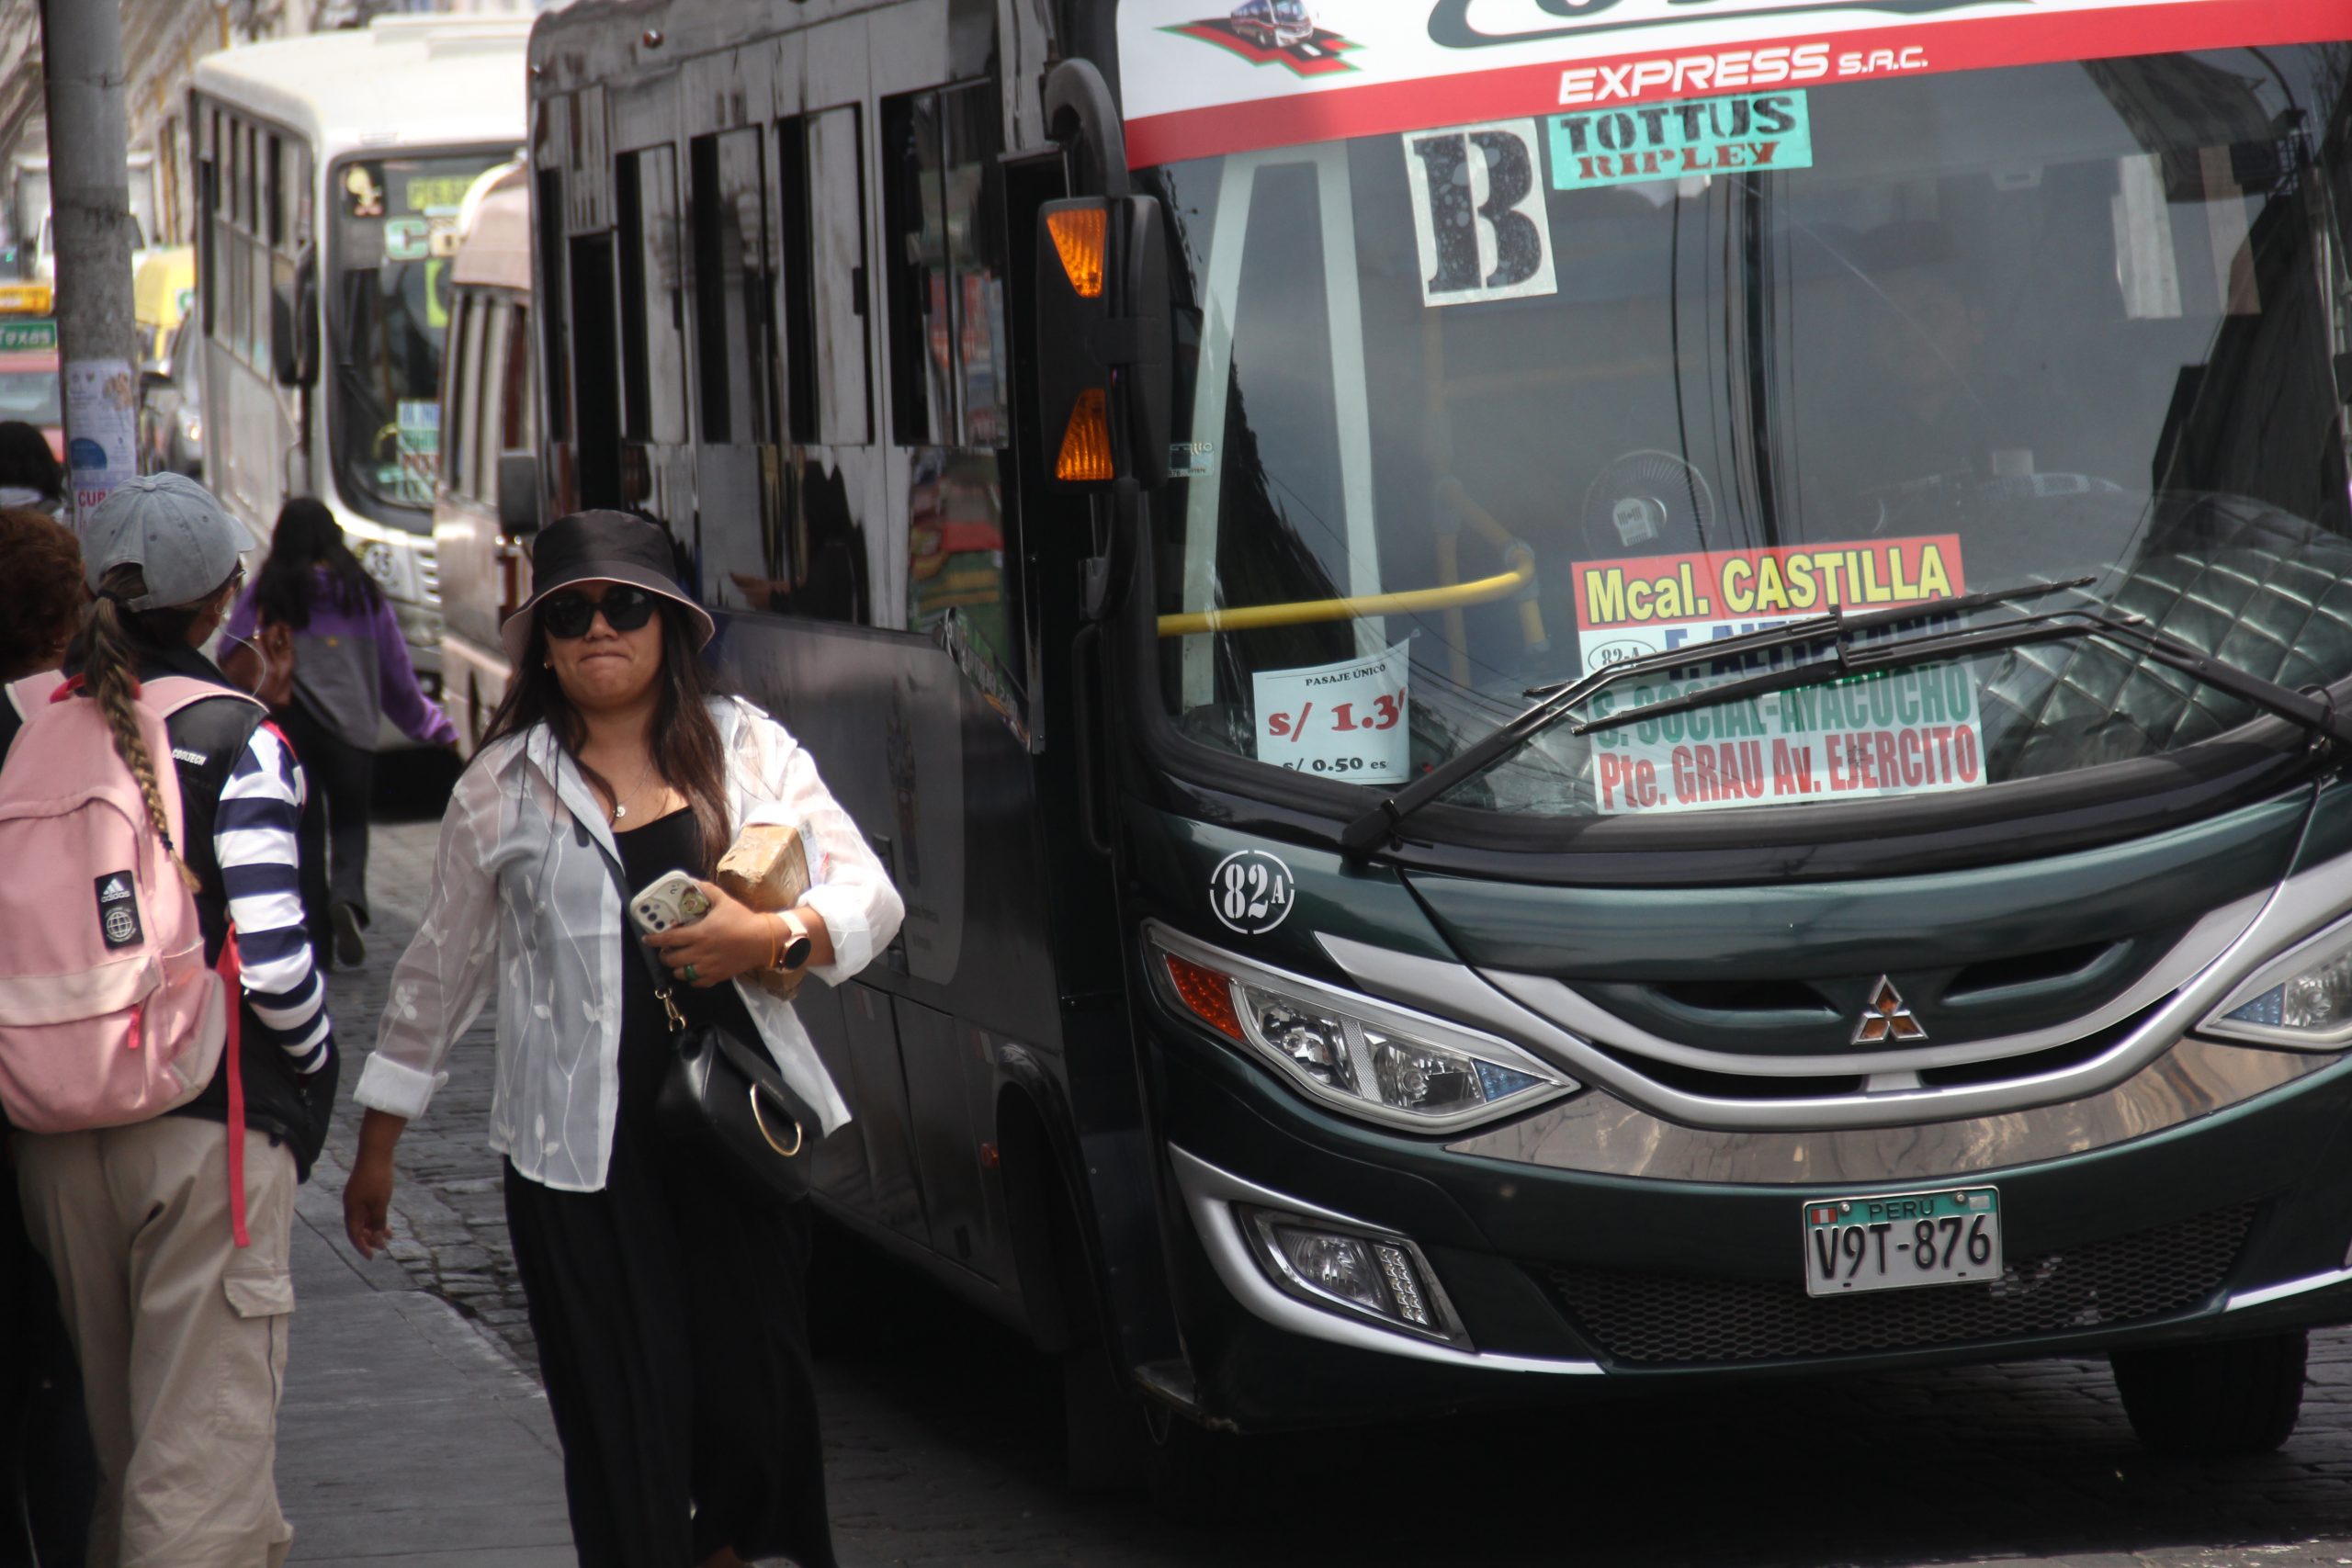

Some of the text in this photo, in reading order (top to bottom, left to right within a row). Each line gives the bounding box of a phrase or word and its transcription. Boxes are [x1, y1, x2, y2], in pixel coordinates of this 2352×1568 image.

[1559, 43, 1929, 106] EXPRESS S.A.C.
[1562, 96, 1796, 155] TOTTUS
[1577, 141, 1781, 180] RIPLEY
[1412, 130, 1544, 294] B
[1585, 543, 1953, 625] Mcal. CASTILLA
[1306, 663, 1386, 687] PASAJE ÚNICO
[172, 748, 208, 767] COOLTECH
[1312, 757, 1364, 773] 0.50
[1599, 724, 1980, 810] Pte. GRAU Av. EJERCITO
[101, 890, 130, 903] adidas
[1224, 863, 1286, 919] 82A
[1868, 1199, 1935, 1221] PERU
[1814, 1213, 1992, 1280] V9T-876
